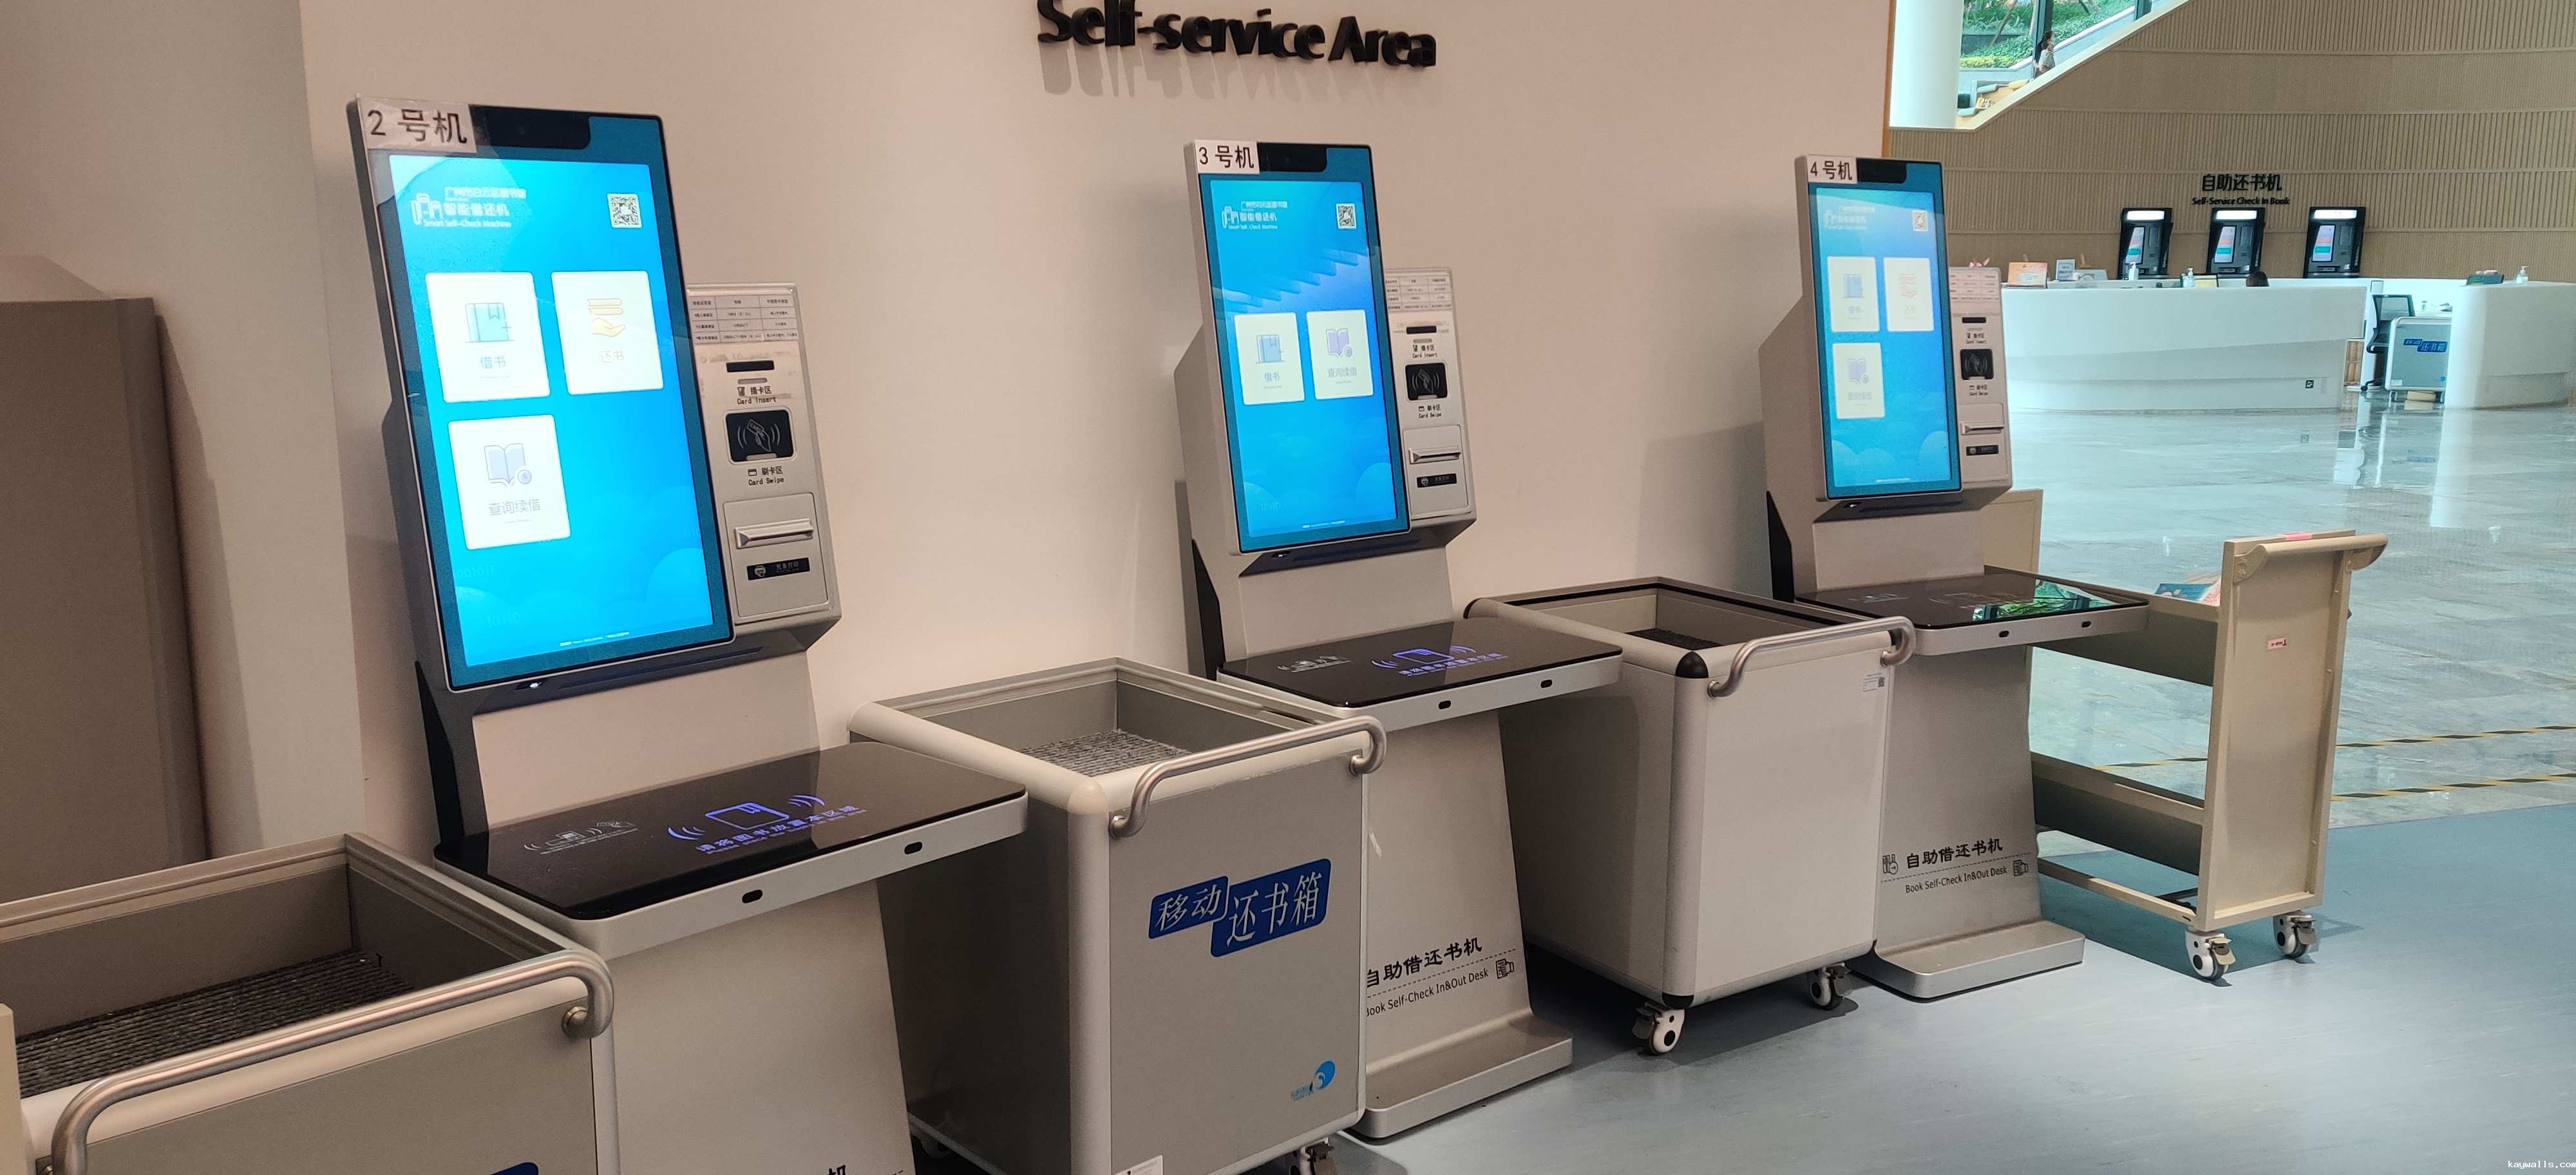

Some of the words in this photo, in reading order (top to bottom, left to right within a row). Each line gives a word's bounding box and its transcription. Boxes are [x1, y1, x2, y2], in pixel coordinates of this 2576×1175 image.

[1037, 0, 1325, 61] Self-service
[1328, 15, 1437, 68] Area
[368, 110, 386, 136] 2
[397, 108, 468, 144] 号机
[1198, 147, 1209, 165] 3
[1215, 145, 1255, 168] 号机
[1810, 162, 1819, 177] 4
[1823, 160, 1853, 181] 号机
[2202, 173, 2282, 191] 自助还书机
[2192, 196, 2235, 205] Self-Service
[2236, 196, 2260, 205] Check
[2261, 196, 2269, 205] In
[2270, 196, 2291, 205] Book
[480, 355, 507, 369] 借书
[750, 386, 772, 395] 插卡区
[755, 396, 777, 405] Insert
[748, 477, 764, 486] Card
[766, 477, 784, 486] Swipe
[489, 499, 541, 516] 查询续借
[1906, 837, 2004, 869] 自助借还书机
[1906, 881, 1924, 893] Book
[1924, 874, 1963, 890] Self-Check
[1964, 870, 1990, 883] In&Out
[1991, 865, 2007, 877] Desk
[1154, 884, 1222, 932] 移动
[1226, 871, 1323, 948] 还书箱
[1367, 937, 1483, 989] 自助借还书机
[1366, 1002, 1386, 1017] ook
[1388, 986, 1435, 1010] Self-Check
[1435, 975, 1468, 995] In&Out
[1468, 968, 1490, 983] Desk
